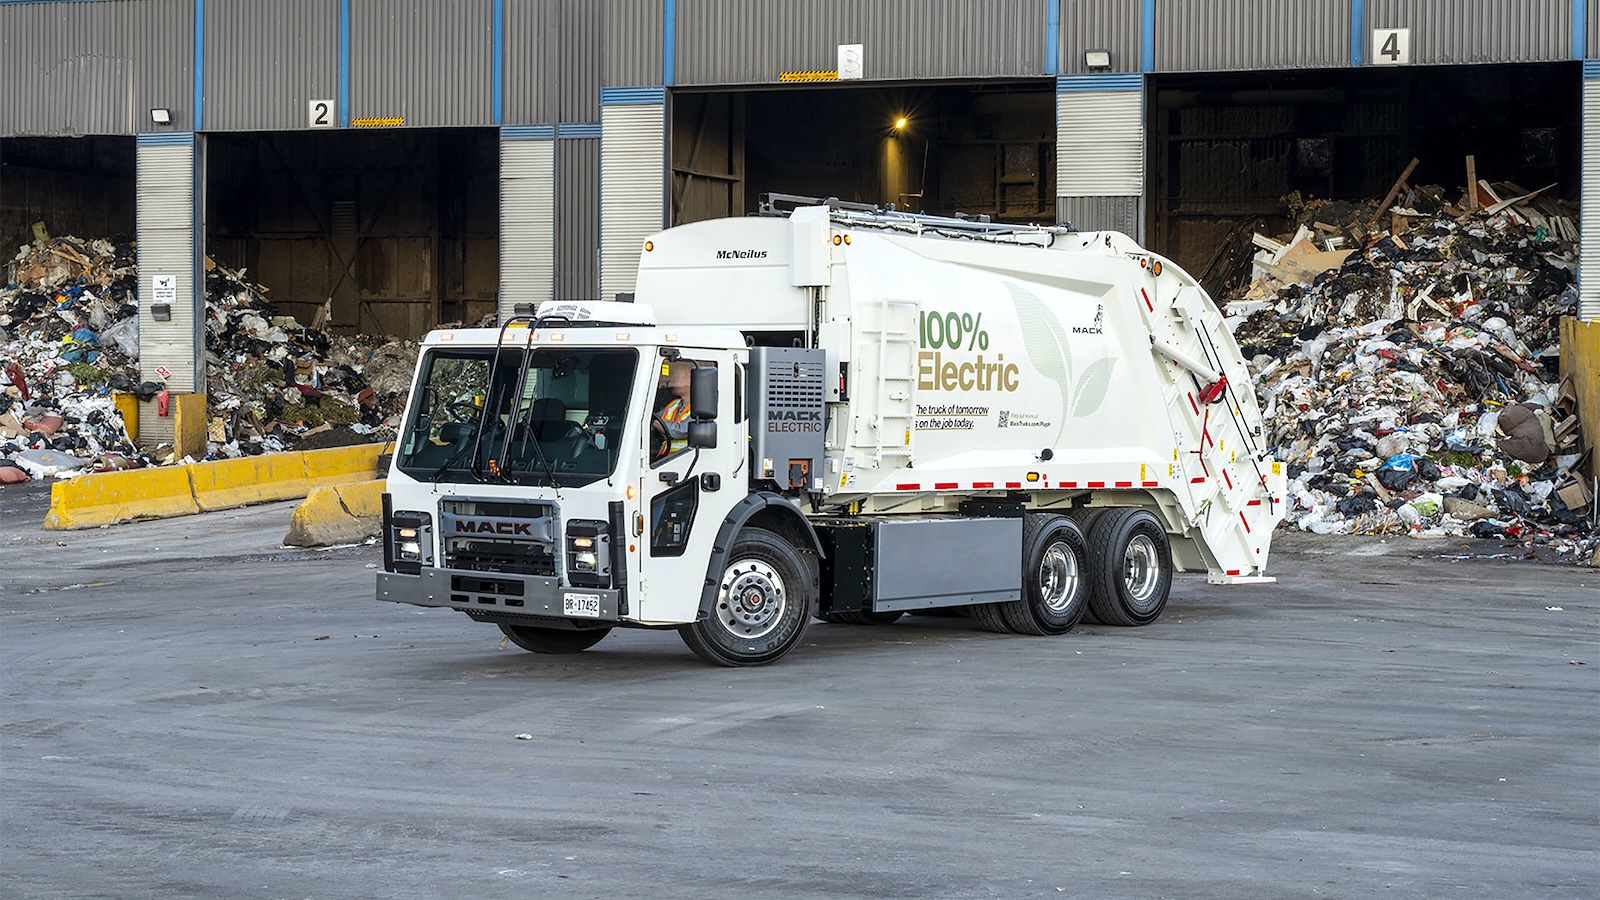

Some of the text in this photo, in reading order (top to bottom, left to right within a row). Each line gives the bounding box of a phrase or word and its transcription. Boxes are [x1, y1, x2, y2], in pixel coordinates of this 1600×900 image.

[1381, 33, 1400, 61] 4
[315, 103, 328, 125] 2
[716, 249, 768, 259] McNeilus
[919, 310, 989, 351] 100%
[1072, 327, 1103, 335] MACK
[918, 351, 1019, 392] Electric
[928, 404, 947, 414] truck
[948, 404, 956, 414] of
[956, 404, 989, 414] tomorrow
[768, 411, 822, 420] MACK
[768, 422, 822, 432] ELECTRIC
[919, 420, 929, 428] on
[929, 418, 942, 428] the
[941, 418, 953, 430] job
[954, 418, 975, 430] today.
[456, 520, 533, 536] MACK
